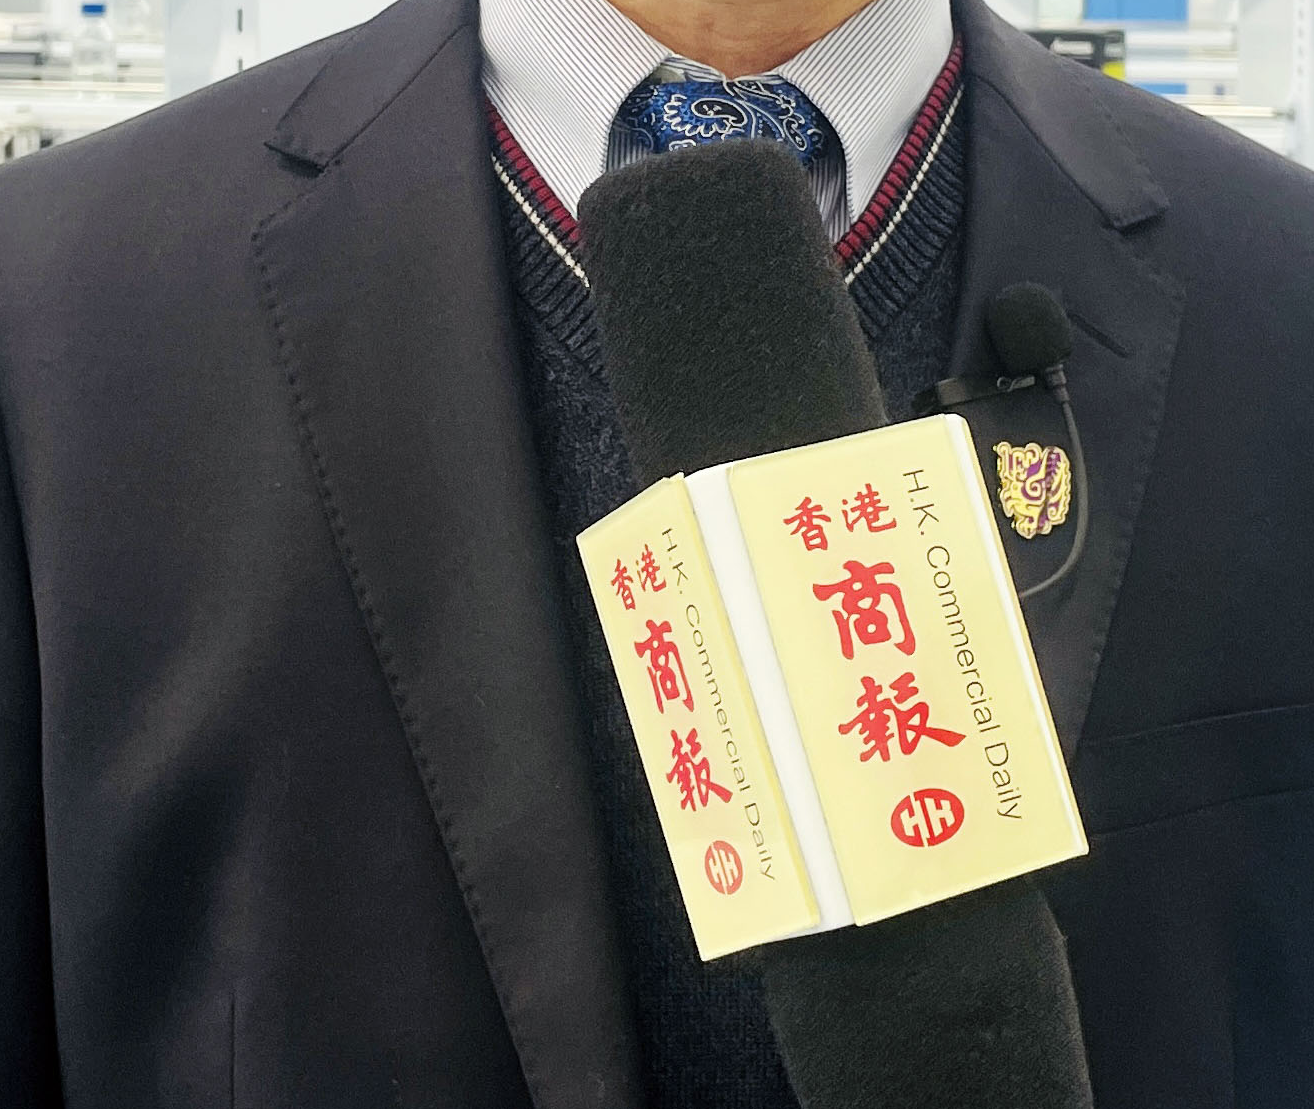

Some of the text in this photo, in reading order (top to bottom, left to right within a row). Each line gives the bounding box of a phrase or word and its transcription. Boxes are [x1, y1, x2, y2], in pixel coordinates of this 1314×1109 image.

[611, 544, 667, 611] 香港
[783, 482, 898, 552] 香港
[661, 528, 776, 880] H.K. Commercial Daily
[902, 469, 1023, 820] H.K. Commercial Daily
